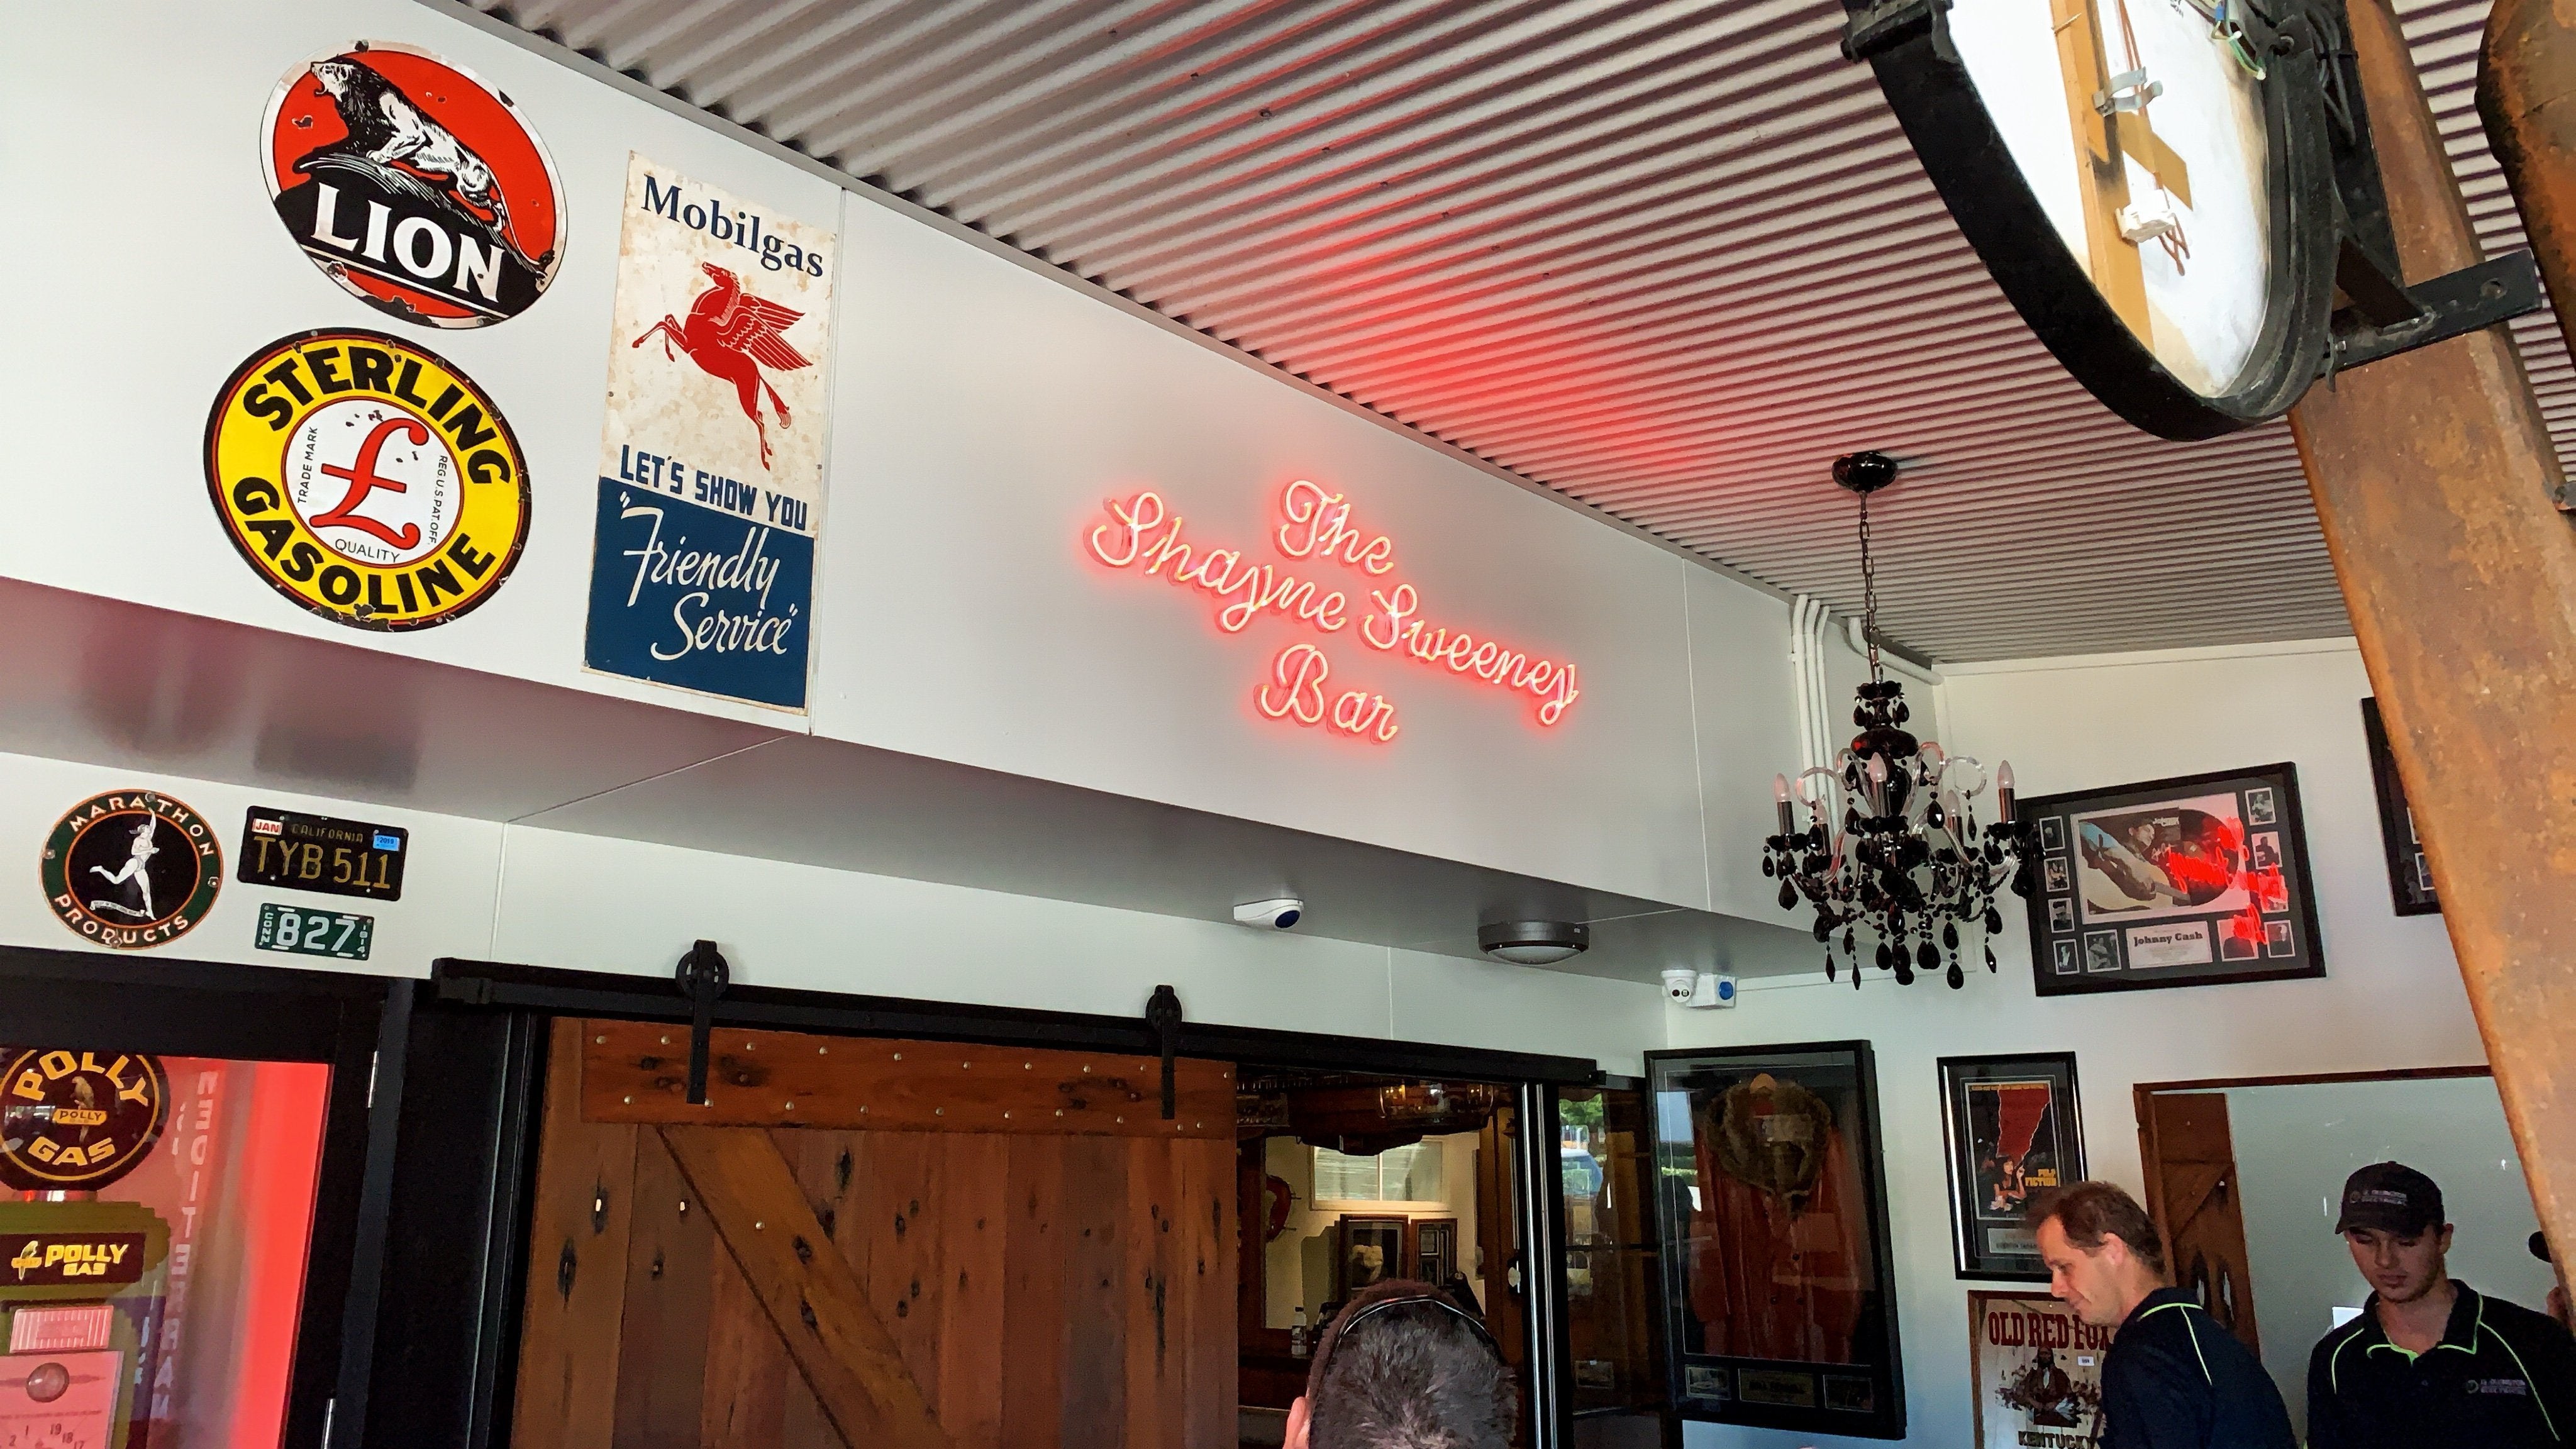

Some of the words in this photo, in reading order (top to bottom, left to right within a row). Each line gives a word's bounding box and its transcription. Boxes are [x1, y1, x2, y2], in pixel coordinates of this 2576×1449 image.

[311, 182, 504, 303] LION
[641, 174, 823, 277] Mobilgas
[243, 346, 511, 484] STERLING
[297, 464, 312, 503] TRADE
[305, 427, 318, 460] MARK
[620, 445, 684, 494] LET'S
[695, 470, 757, 516] SHOW
[765, 491, 807, 531] YOU
[233, 476, 496, 614] GASOLINE
[335, 538, 400, 562] QUALITY
[1279, 480, 1394, 575] The
[1092, 492, 1346, 631] Shayne
[1363, 584, 1579, 726] Sweeney
[1260, 643, 1399, 741] Bar
[69, 796, 214, 855] MARATHON
[256, 821, 280, 833] JAN
[291, 823, 364, 843] CALIFORNIA
[253, 836, 323, 880] TYB
[333, 848, 391, 889] 511
[55, 894, 188, 944] PRODUCTS
[260, 912, 274, 943] CONN
[276, 913, 355, 952] 827
[2134, 935, 2172, 947] Johnny
[2175, 932, 2203, 941] Cash
[12, 1051, 148, 1107] POLLY
[59, 1111, 101, 1121] POLLY
[28, 1136, 116, 1166] GAS
[45, 1244, 130, 1267] POLLY
[64, 1263, 106, 1275] GAS
[1989, 1311, 2024, 1346] OLD
[2027, 1313, 2070, 1349] RED
